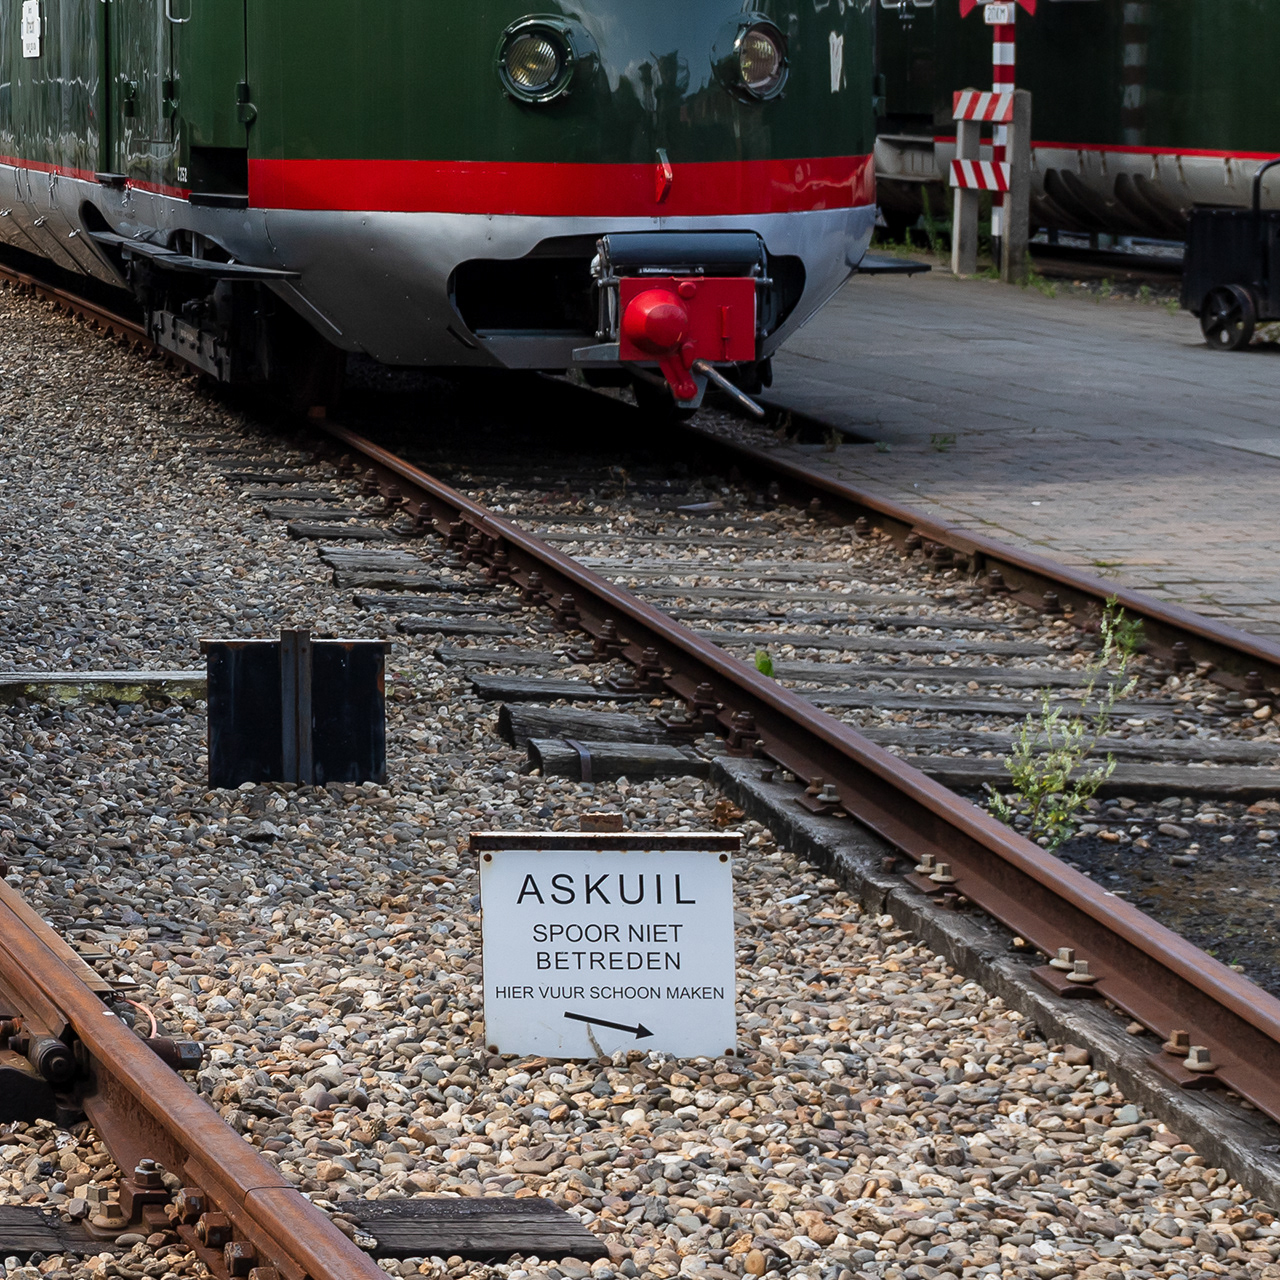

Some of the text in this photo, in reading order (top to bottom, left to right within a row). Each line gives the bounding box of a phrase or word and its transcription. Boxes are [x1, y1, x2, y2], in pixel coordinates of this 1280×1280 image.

[516, 872, 698, 906] ASKUIL
[532, 922, 684, 944] SPOOR NIET
[536, 950, 682, 971] BETREDEN
[495, 985, 725, 1001] HIER VUUR SCHOON MAKEN
